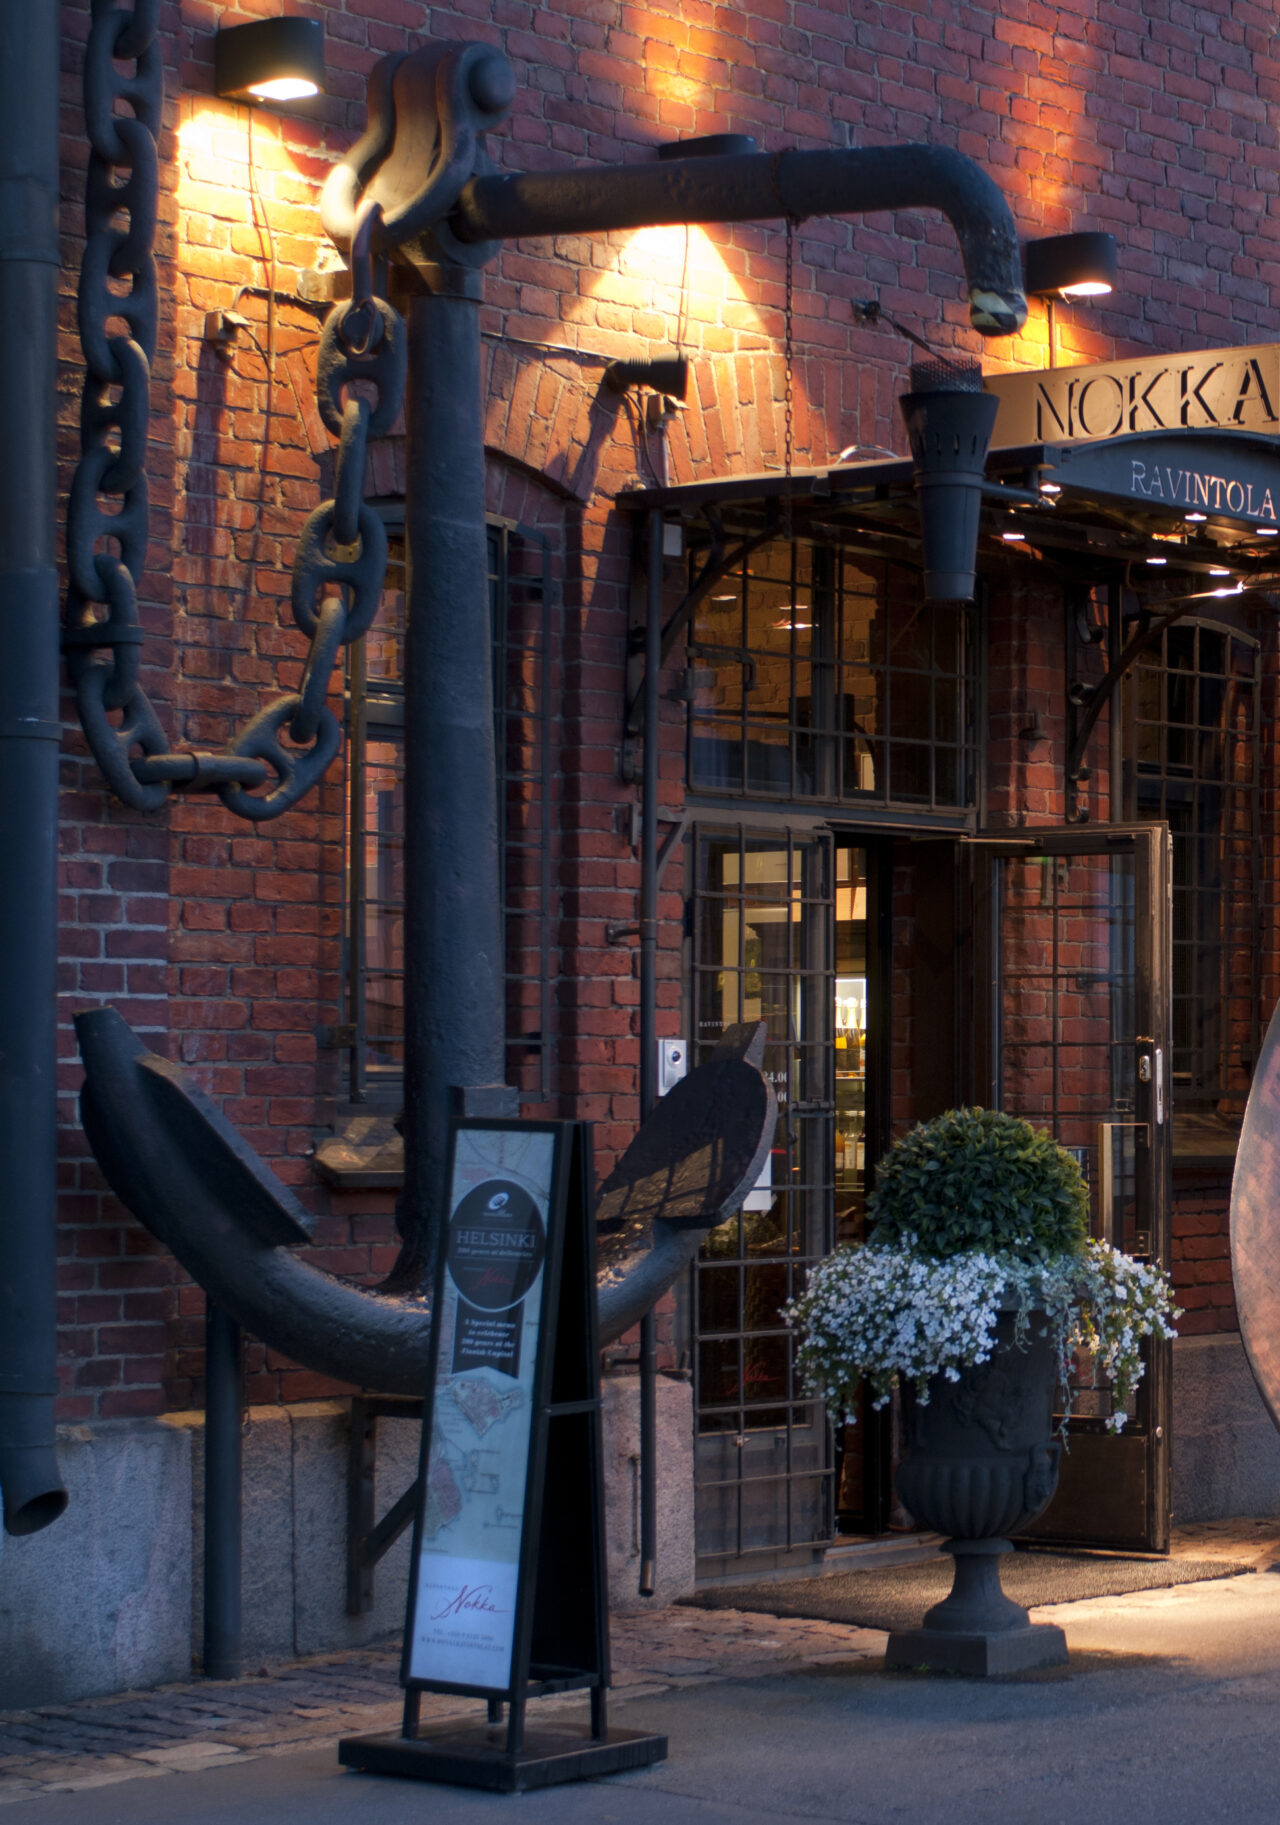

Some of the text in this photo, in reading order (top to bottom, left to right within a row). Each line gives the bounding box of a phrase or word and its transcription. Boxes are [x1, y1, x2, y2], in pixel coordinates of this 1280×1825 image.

[1036, 358, 1279, 440] NOKKA
[1131, 460, 1276, 520] RAVINTOLA
[456, 1230, 537, 1249] HELSINKI
[430, 1584, 512, 1620] Nokka
